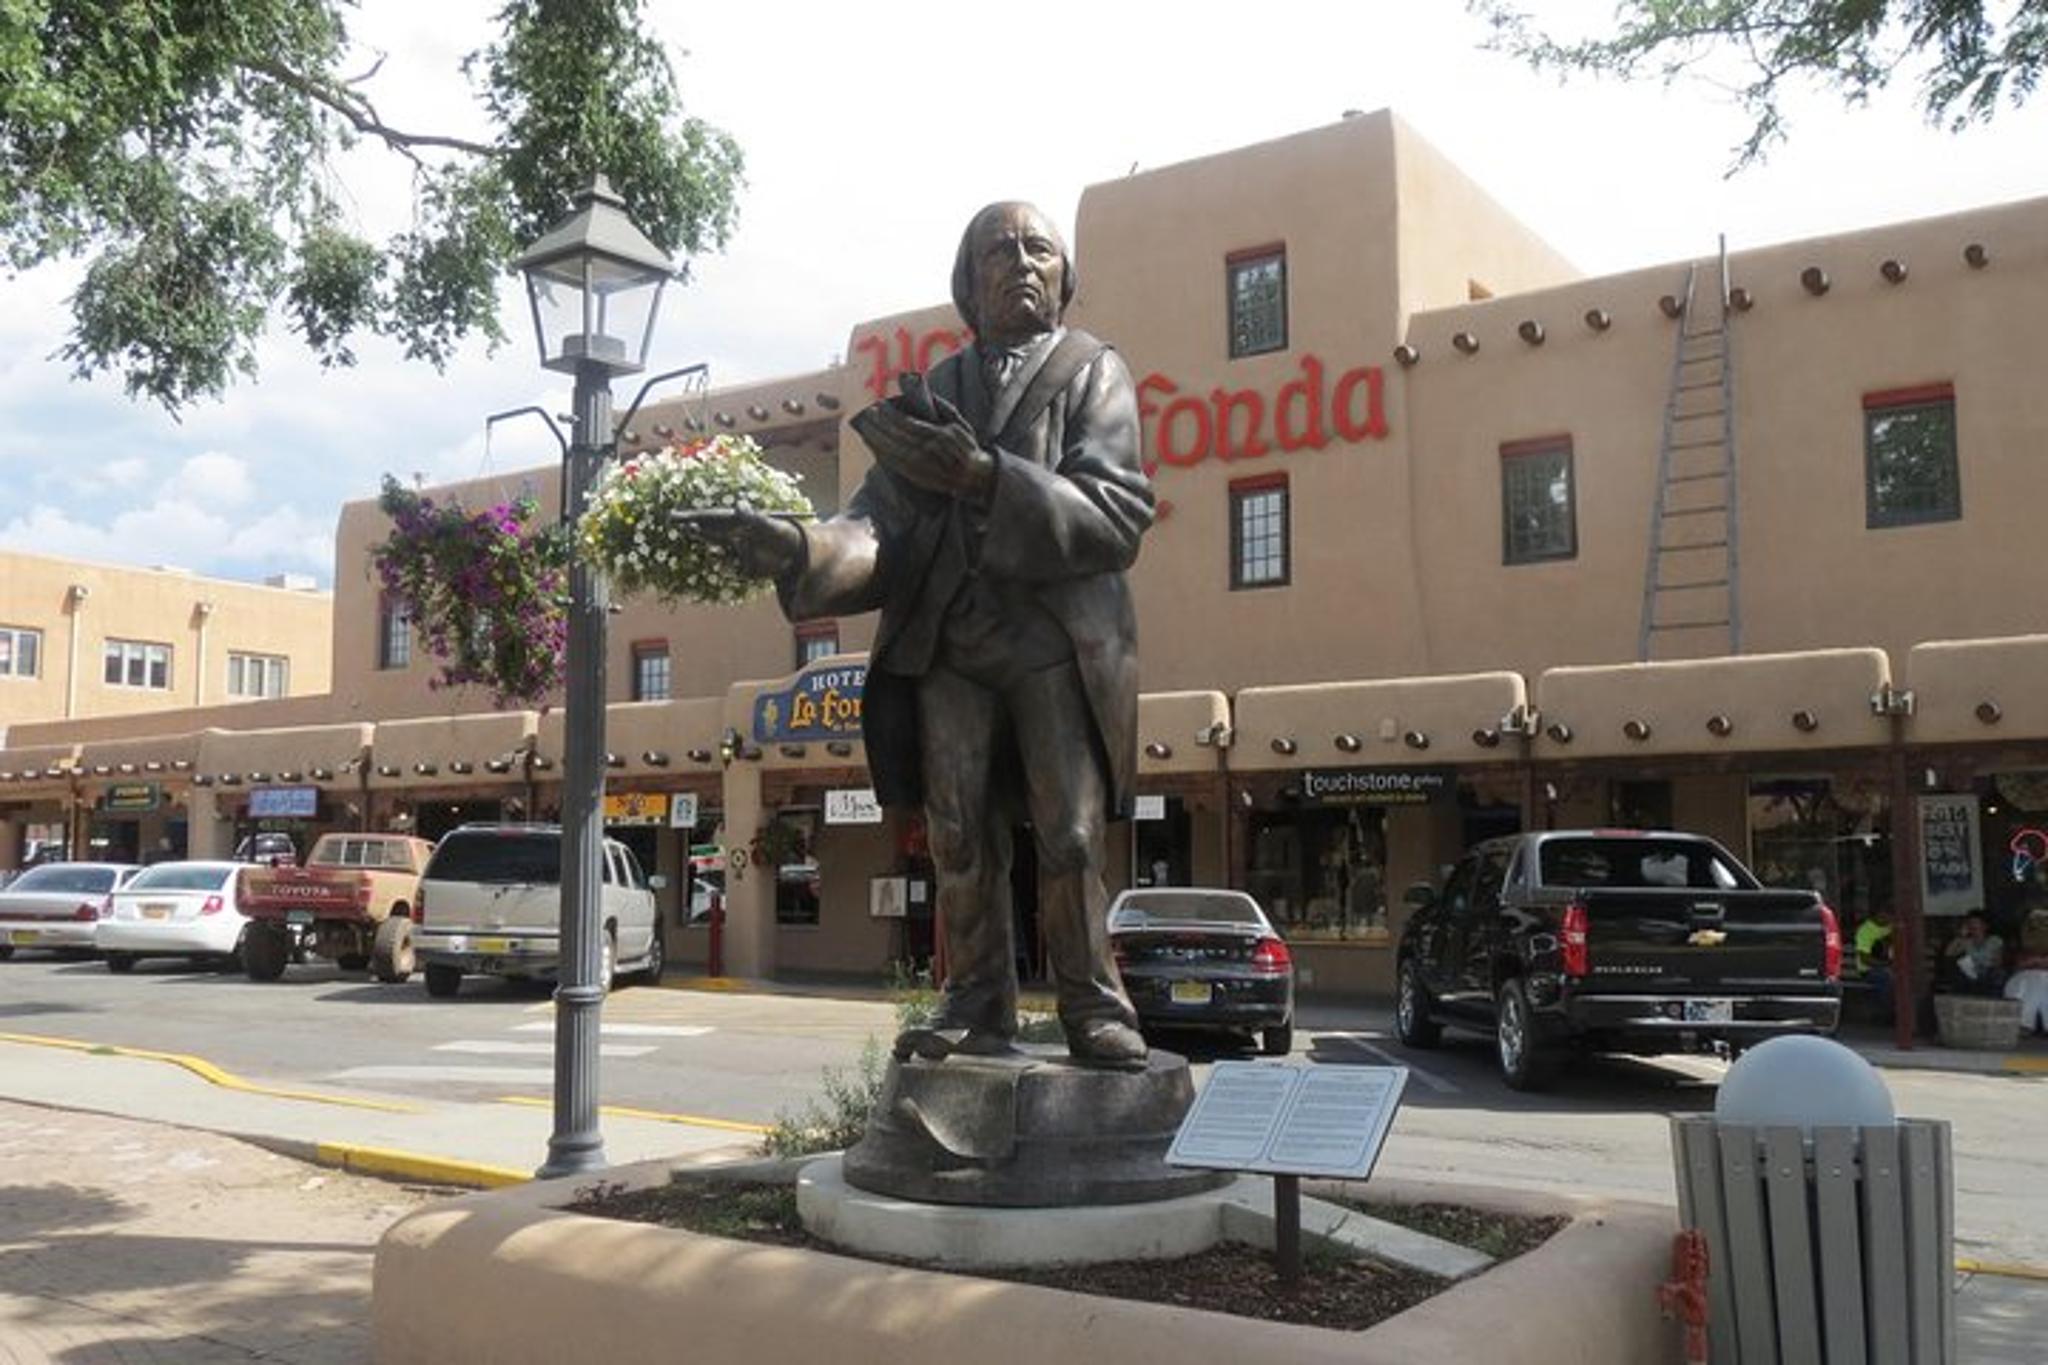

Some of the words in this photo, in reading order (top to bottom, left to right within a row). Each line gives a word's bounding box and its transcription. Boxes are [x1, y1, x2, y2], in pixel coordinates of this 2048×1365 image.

[855, 325, 975, 400] Ho
[811, 670, 865, 692] HOTE
[789, 692, 817, 729] La
[1304, 770, 1411, 797] touchstone
